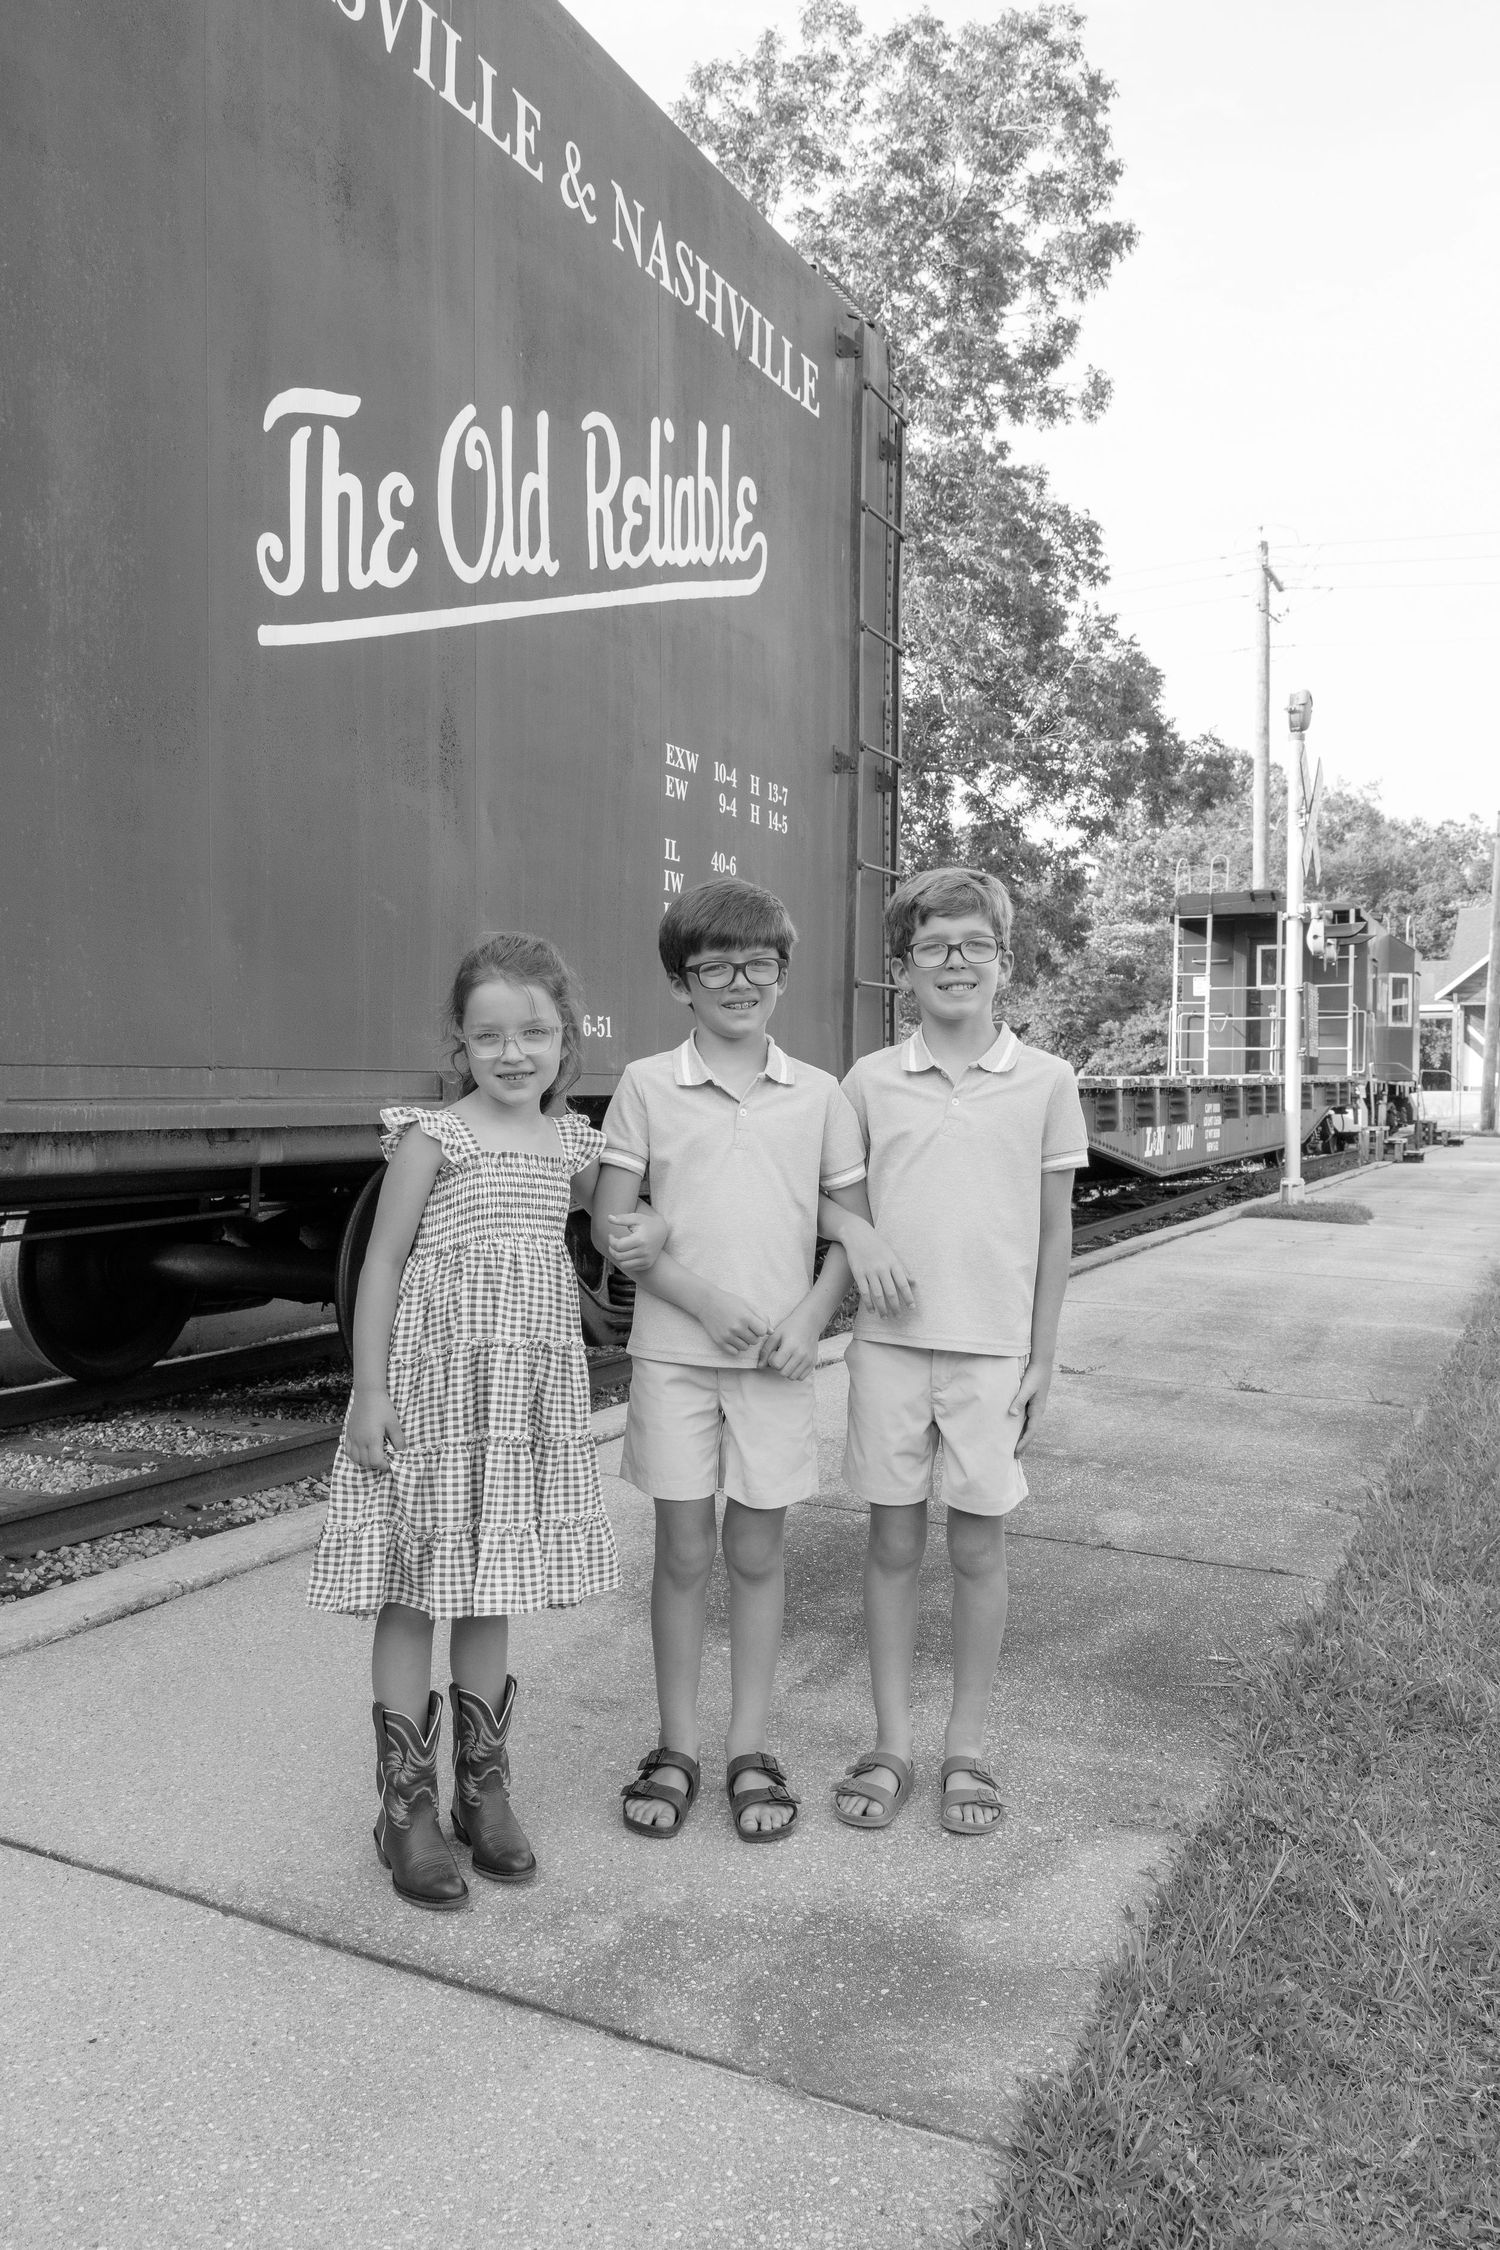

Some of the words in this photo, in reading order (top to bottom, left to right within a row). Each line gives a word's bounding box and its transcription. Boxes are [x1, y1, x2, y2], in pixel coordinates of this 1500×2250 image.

[332, 0, 543, 183] VILLE
[560, 141, 596, 224] &
[611, 180, 820, 418] NASHVILLE
[257, 387, 417, 596] The
[438, 404, 559, 583] Old
[581, 412, 767, 572] Reliable
[665, 743, 699, 774] EXW
[713, 761, 737, 788] 10-4
[750, 774, 761, 797] H
[767, 782, 788, 806] 13-7
[665, 775, 688, 801] EW
[718, 793, 737, 817] 9-4
[750, 803, 761, 825] H
[768, 810, 788, 834] 14-5
[664, 838, 680, 862] IL
[710, 851, 737, 876] 40-6
[664, 869, 684, 894] IW
[582, 1014, 613, 1038] 6-51
